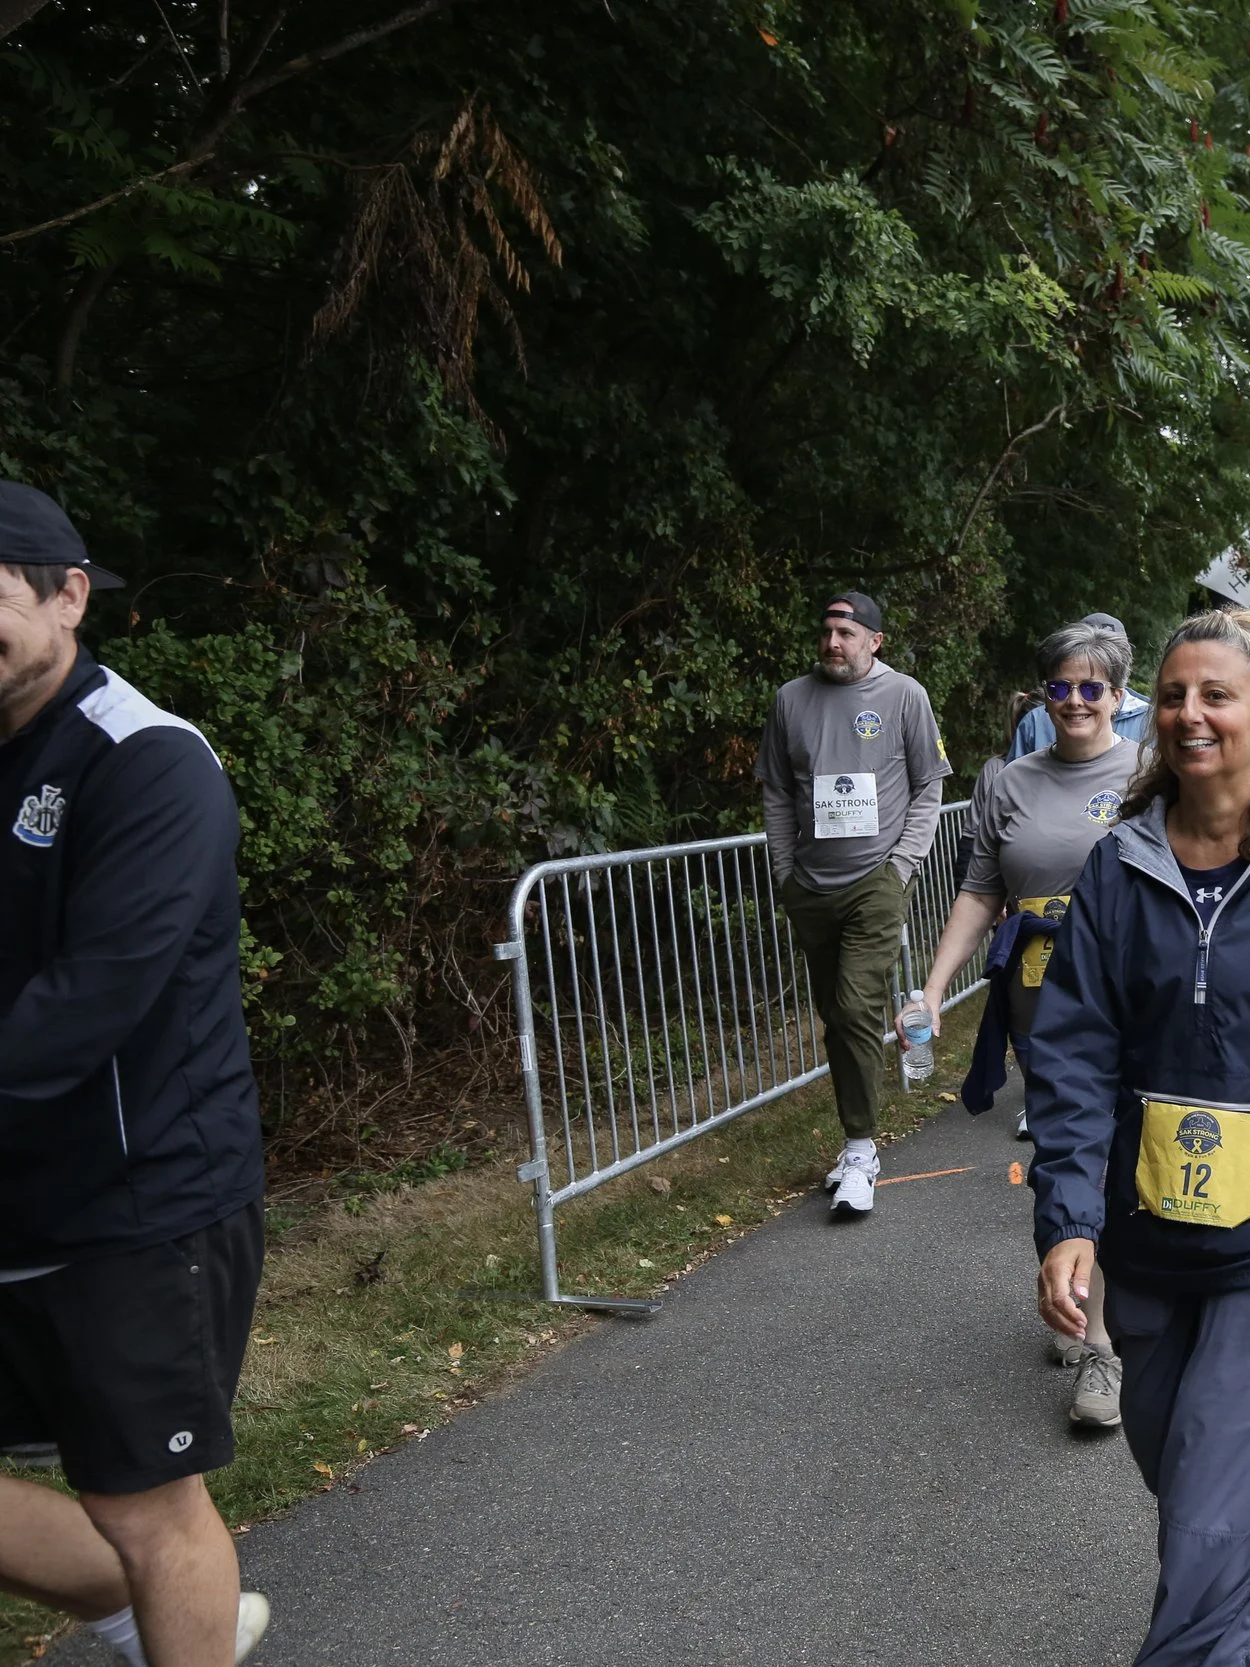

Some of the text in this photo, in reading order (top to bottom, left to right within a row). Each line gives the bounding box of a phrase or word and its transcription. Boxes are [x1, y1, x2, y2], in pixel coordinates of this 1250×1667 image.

[815, 798, 877, 809] SAK STRONG
[1193, 1129, 1219, 1140] STRONG
[1180, 1162, 1212, 1198] 12
[1173, 1199, 1221, 1213] DUFFY
